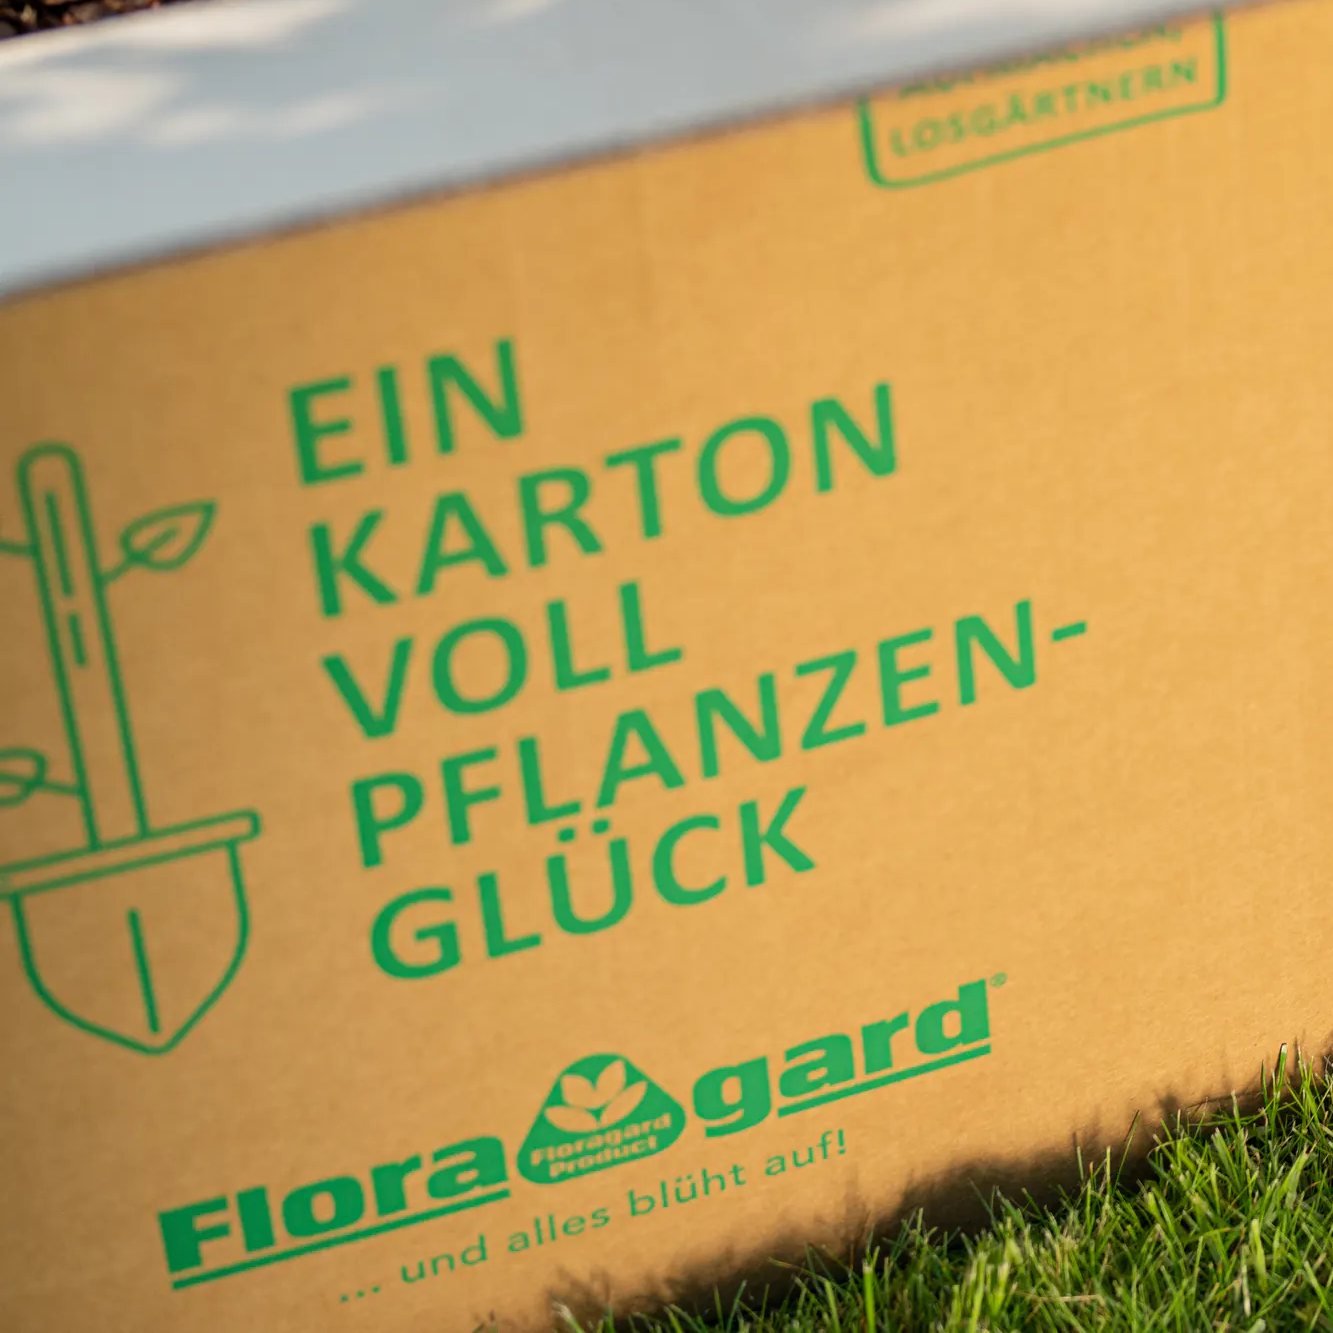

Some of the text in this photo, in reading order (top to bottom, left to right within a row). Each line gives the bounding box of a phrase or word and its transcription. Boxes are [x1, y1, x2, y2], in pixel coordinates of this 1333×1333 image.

[890, 55, 1198, 158] LOSGÄRTNERN
[287, 337, 525, 486] EIN
[308, 382, 898, 618] KARTON
[320, 581, 683, 740] VOLL
[350, 598, 1087, 869] PFLANZEN-
[369, 785, 816, 980] GLÜCK
[400, 1234, 488, 1284] und
[507, 1207, 611, 1253] alles
[627, 1162, 747, 1218] blüht
[764, 1128, 848, 1178] auf!
[530, 1113, 672, 1166] Floragard
[549, 1135, 658, 1178] Product
